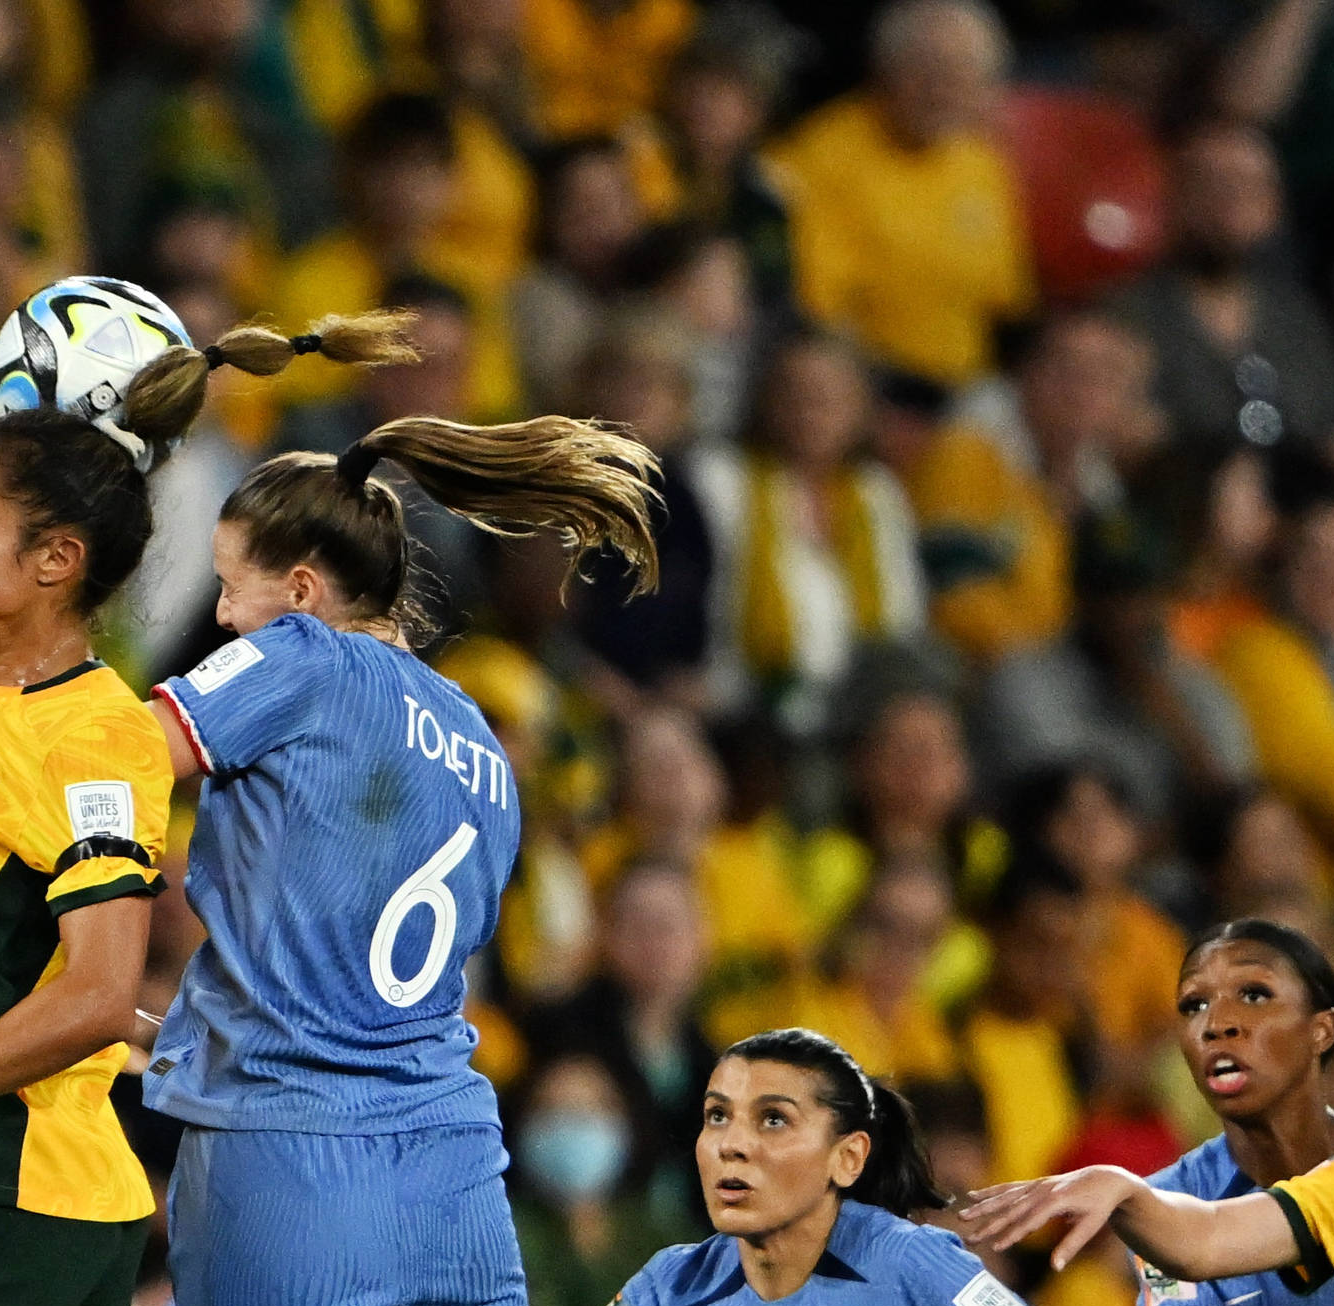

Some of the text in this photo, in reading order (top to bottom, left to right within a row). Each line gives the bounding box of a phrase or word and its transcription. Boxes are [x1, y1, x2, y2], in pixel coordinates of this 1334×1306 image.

[403, 694, 507, 811] TOLETTI
[79, 792, 117, 804] FOOTBALL
[80, 803, 118, 818] UNITES
[368, 821, 479, 1008] 6
